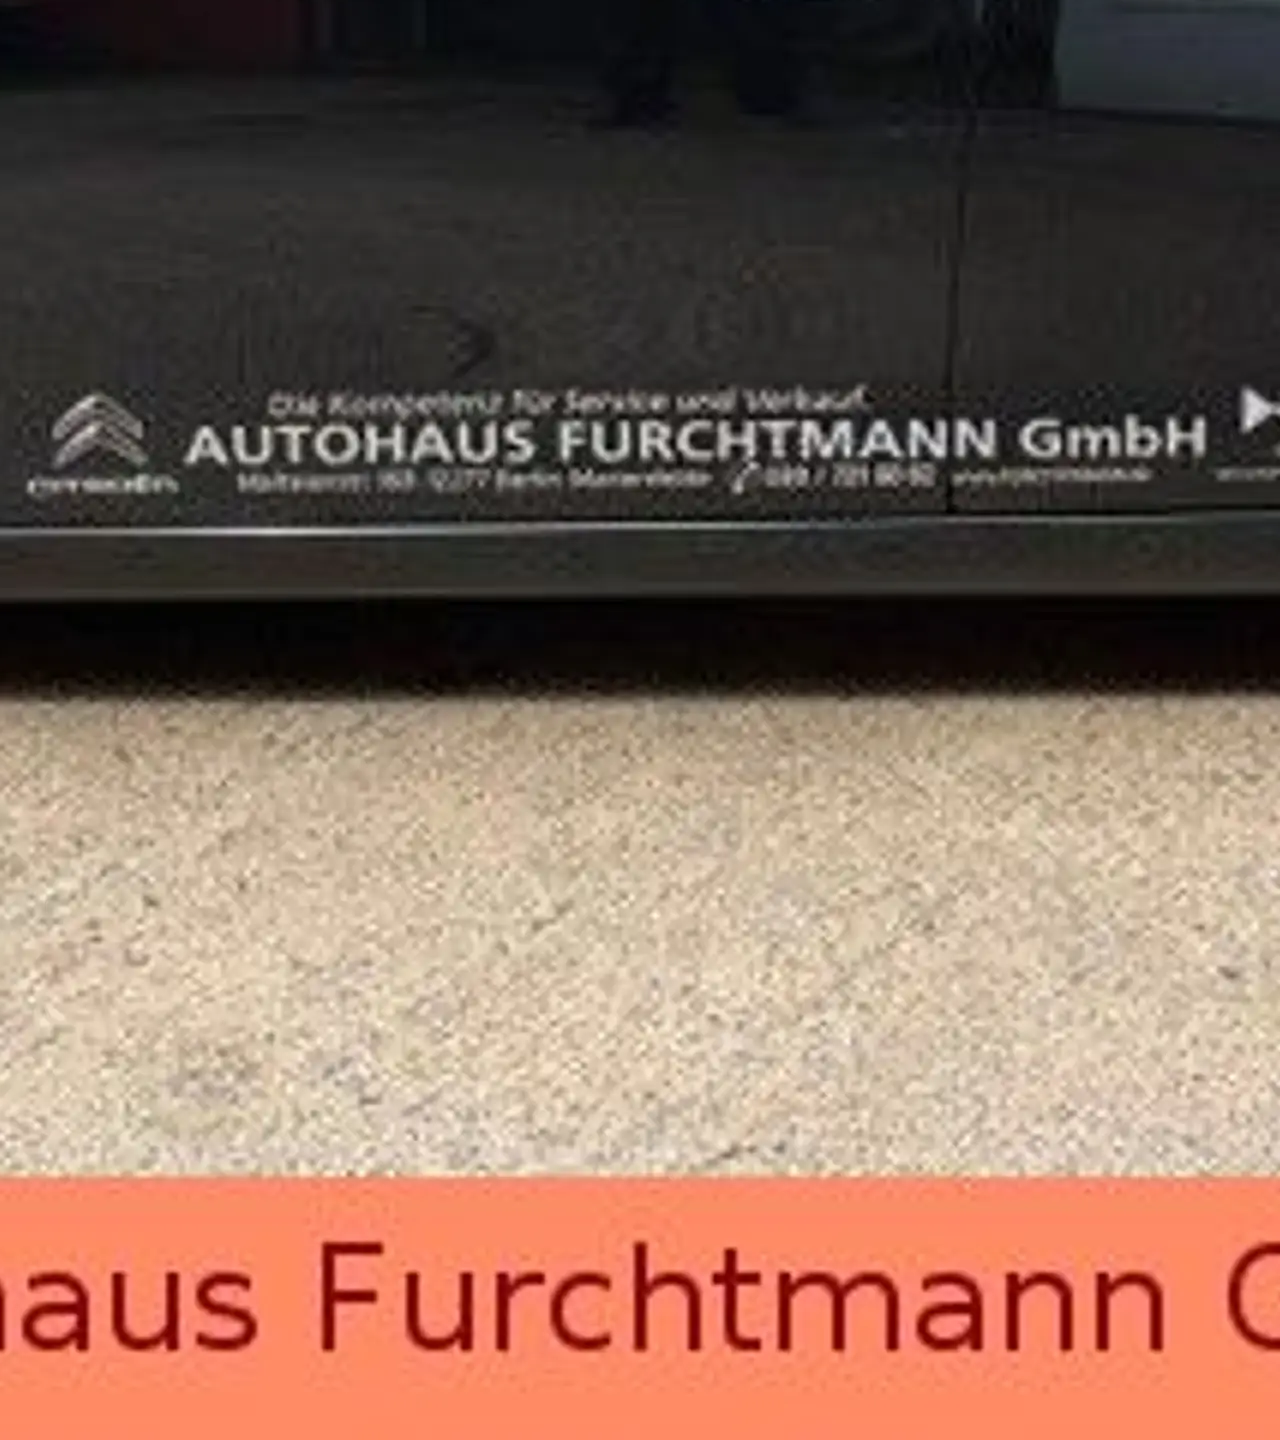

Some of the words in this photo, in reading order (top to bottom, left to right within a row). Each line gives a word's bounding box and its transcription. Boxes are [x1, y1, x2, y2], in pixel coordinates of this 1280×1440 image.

[183, 421, 537, 465] AUTOHAUS
[559, 417, 998, 462] FURCHTMANN
[1019, 413, 1208, 459] GmbH
